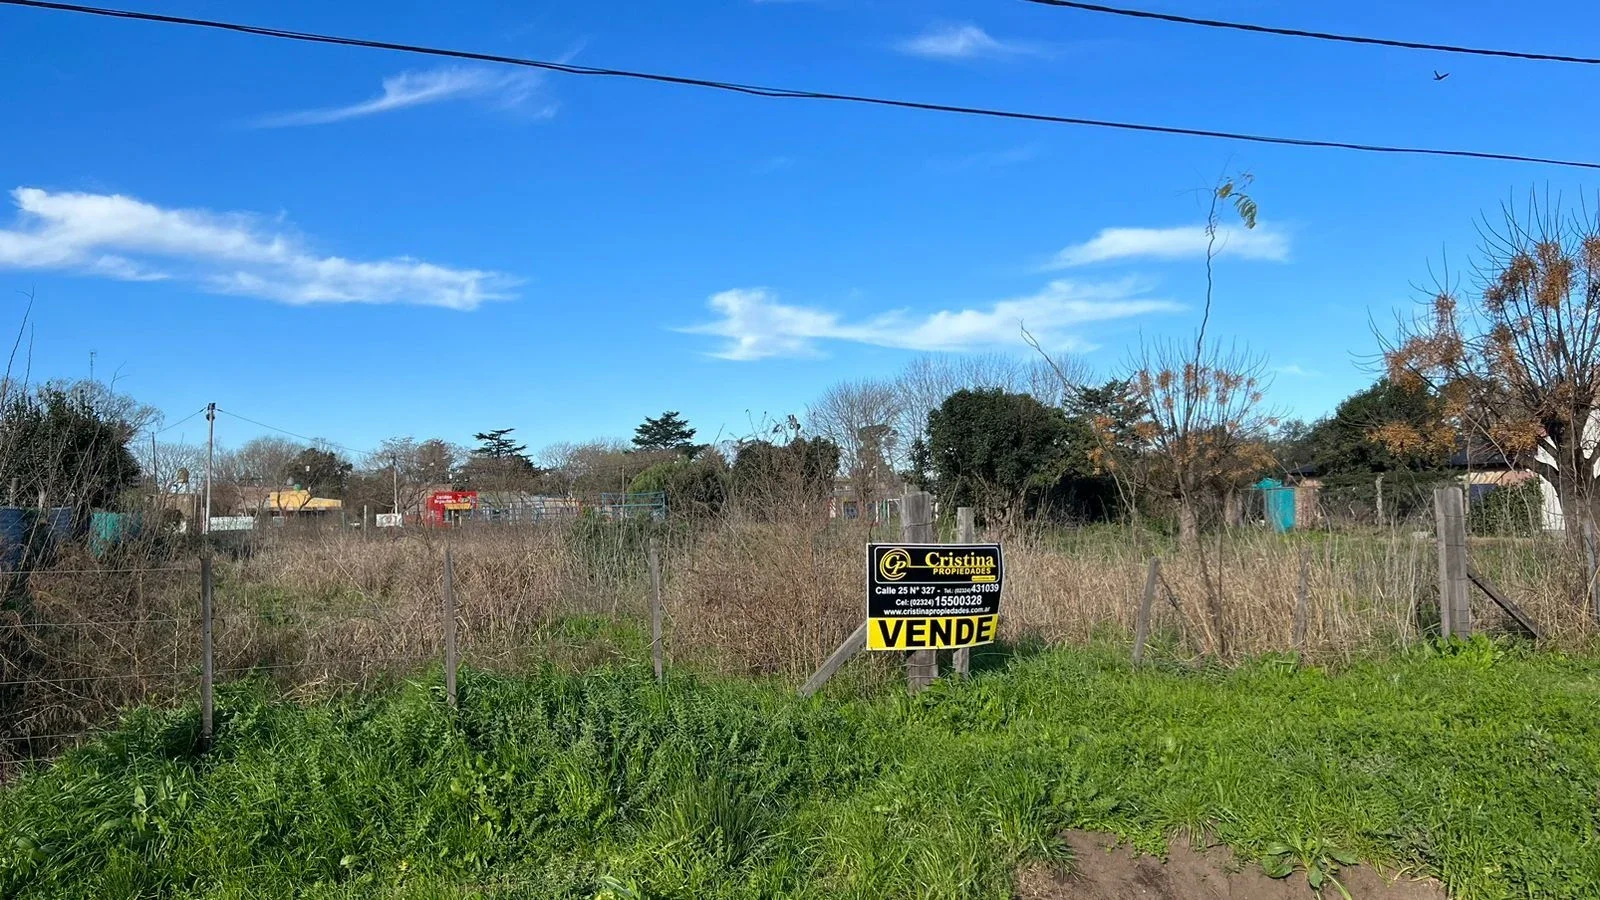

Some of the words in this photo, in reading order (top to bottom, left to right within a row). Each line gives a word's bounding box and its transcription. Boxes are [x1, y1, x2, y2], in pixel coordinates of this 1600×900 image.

[925, 551, 996, 568] Cristina
[933, 567, 991, 575] PROPIEDADES
[875, 586, 897, 595] Calle
[898, 586, 909, 595] 25
[921, 586, 936, 595] 327
[971, 583, 999, 593] 431039
[910, 598, 934, 607] (02324)
[934, 595, 982, 607] 15500328
[883, 607, 991, 616] www.cristinapropiedades.com.ar
[878, 616, 993, 647] VENDE
